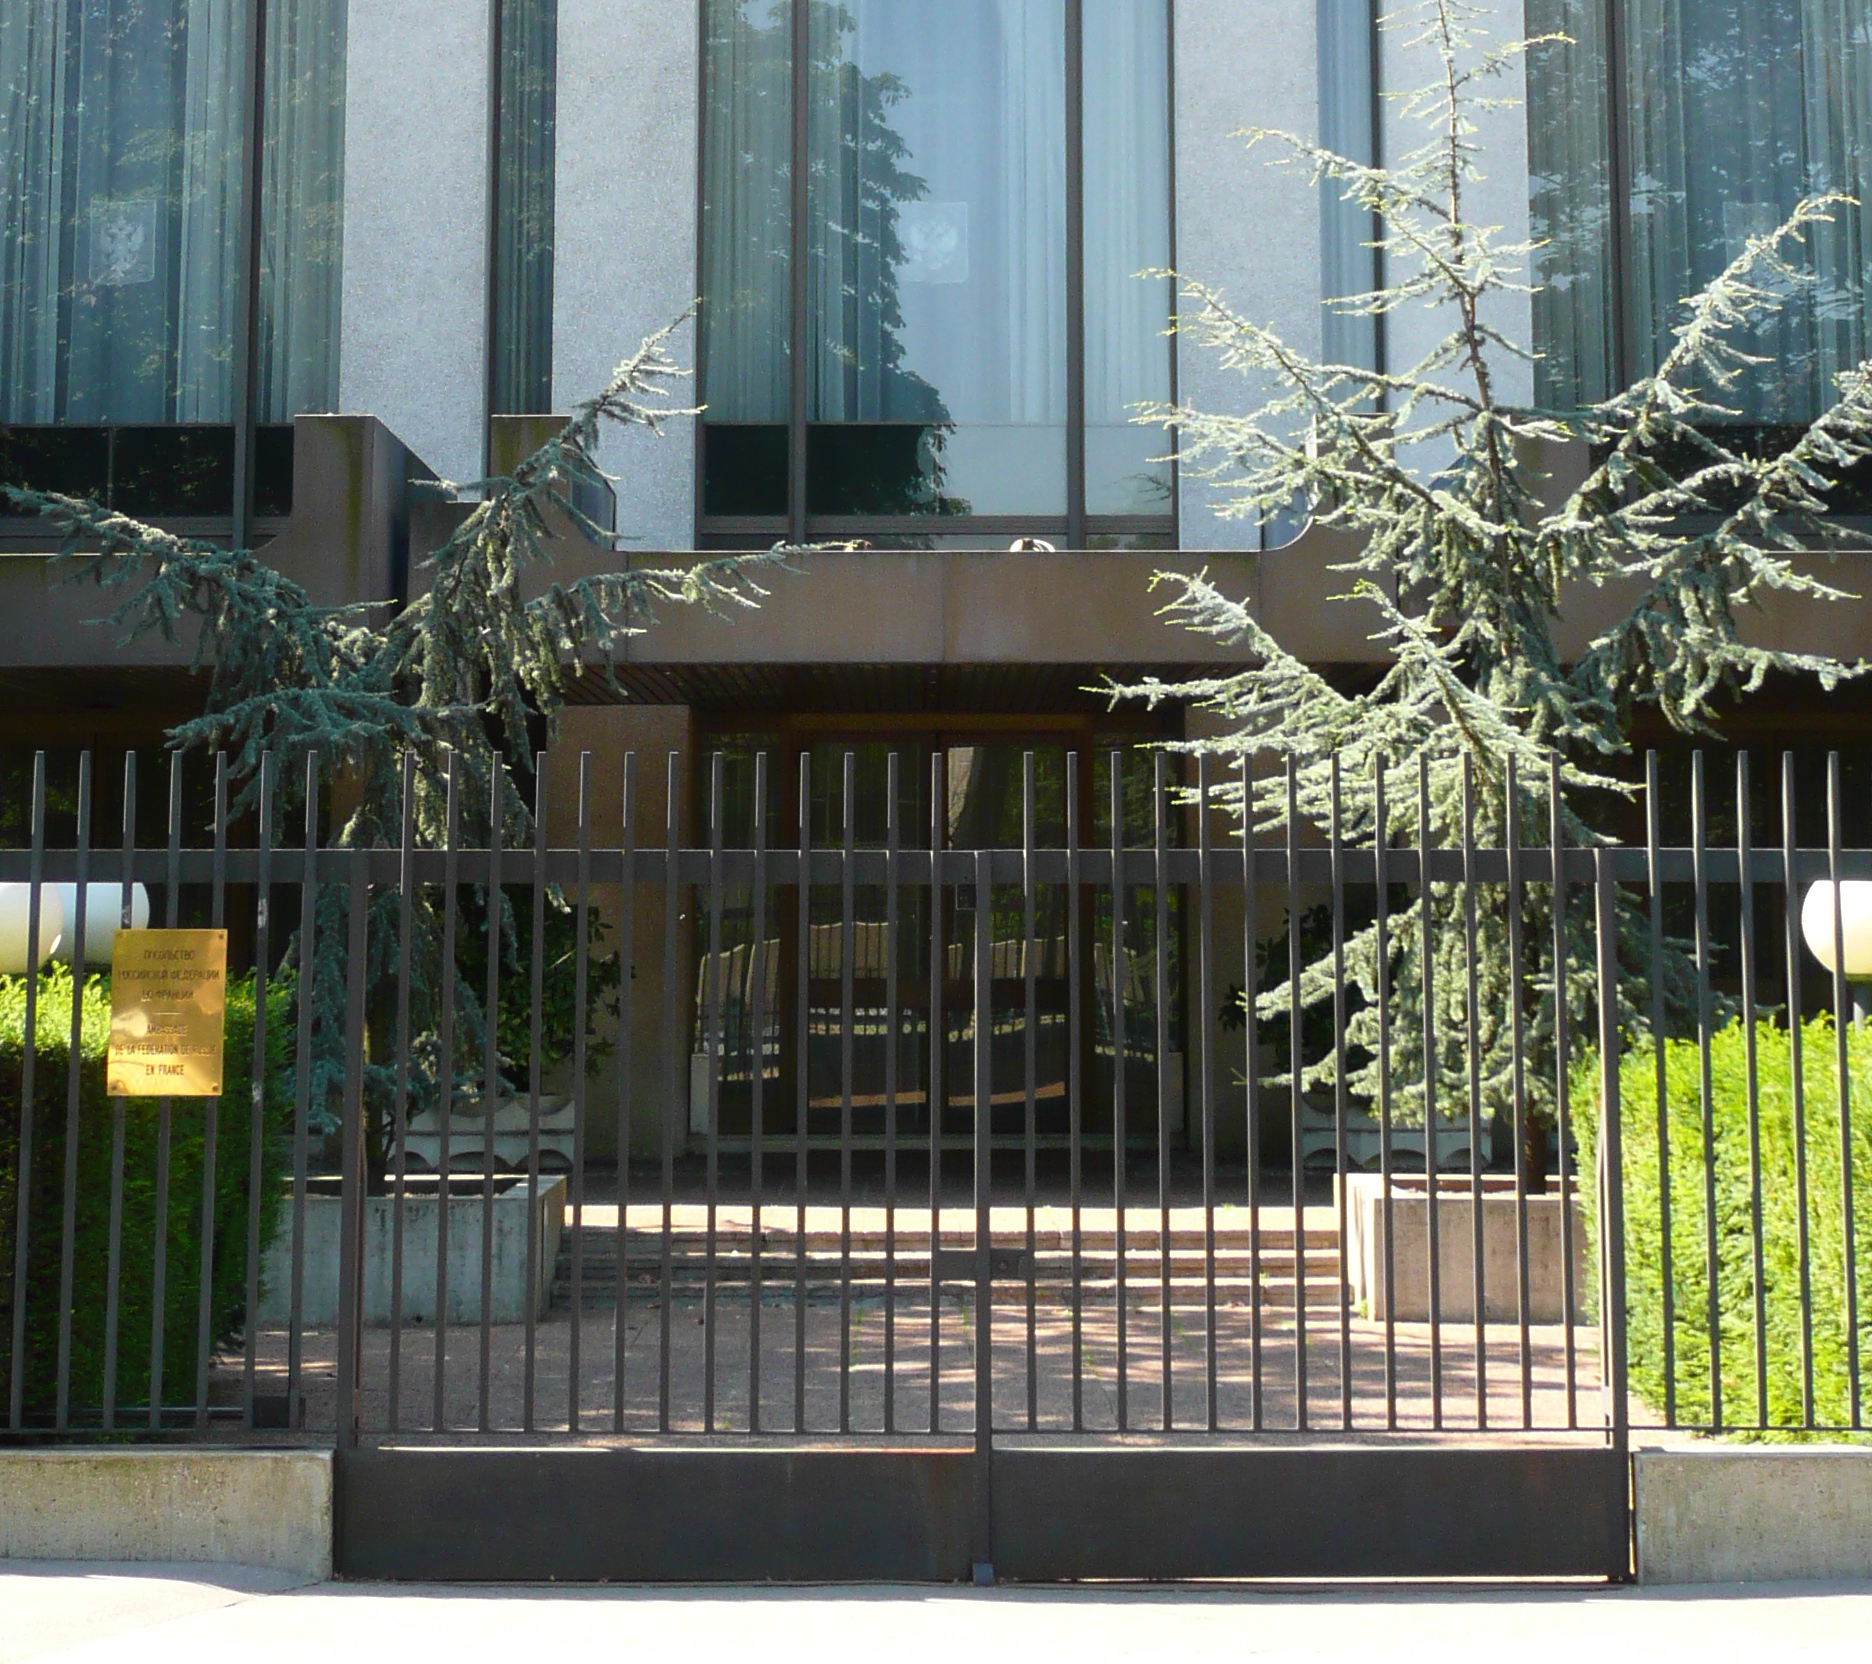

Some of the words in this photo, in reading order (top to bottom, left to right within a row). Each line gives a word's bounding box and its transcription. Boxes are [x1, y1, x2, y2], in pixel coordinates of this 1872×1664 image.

[115, 1044, 123, 1055] DE
[127, 1044, 135, 1055] LA
[145, 1064, 155, 1076] EN
[158, 1064, 185, 1076] FRANCE
